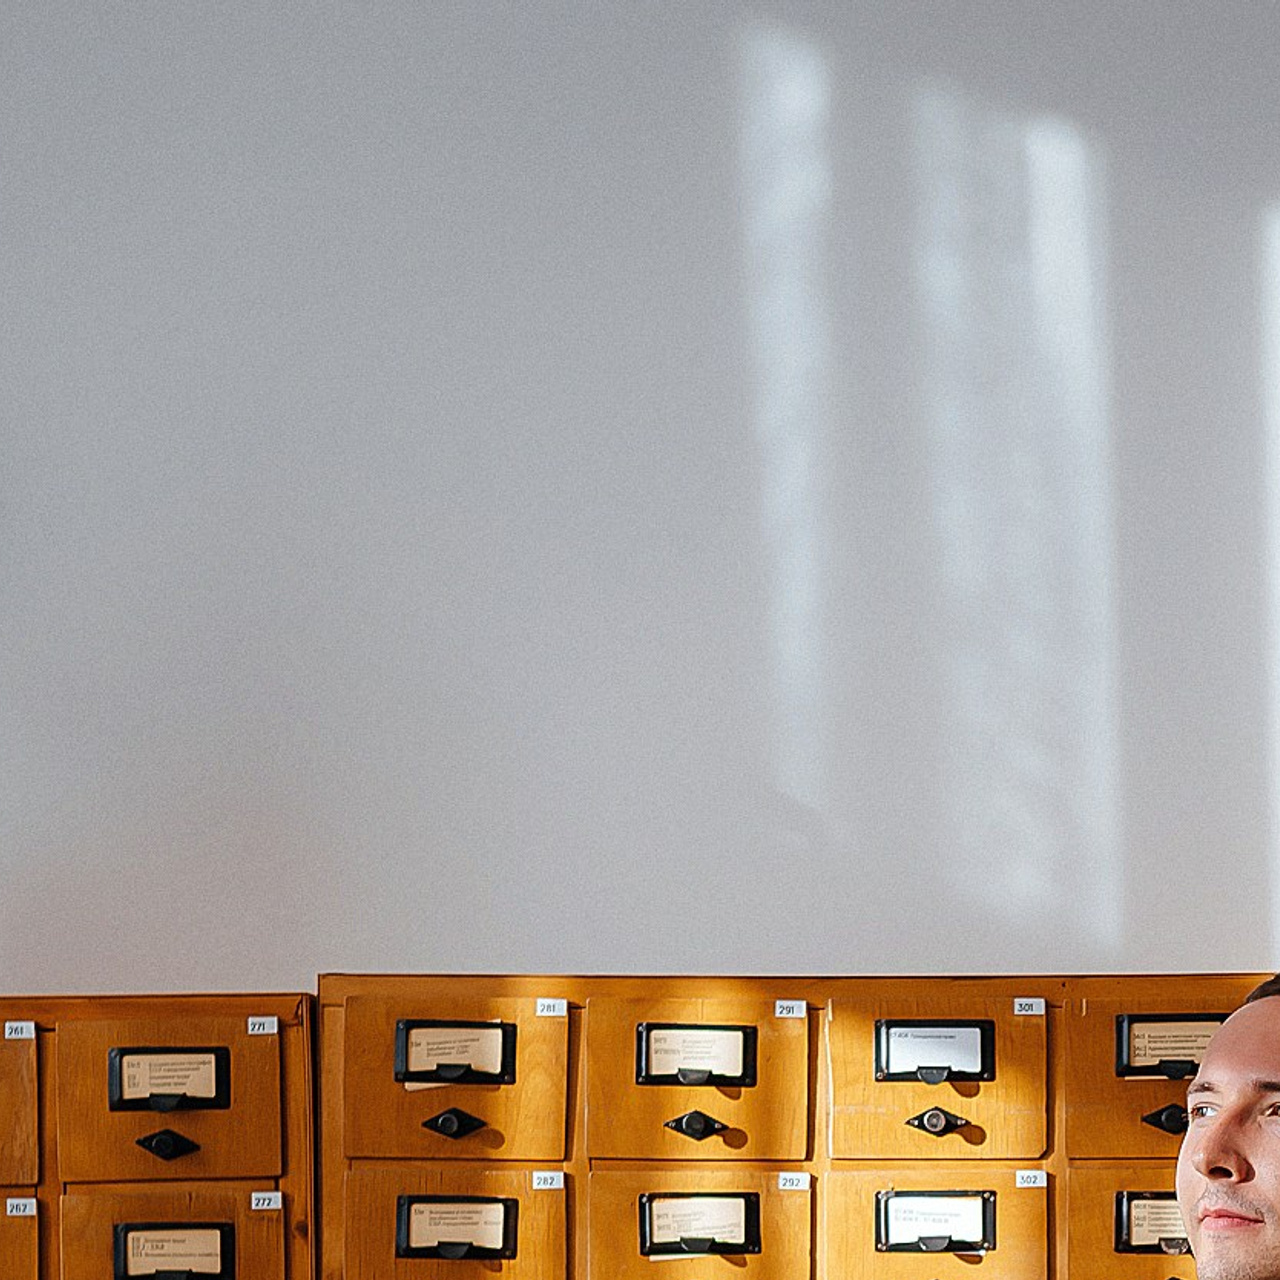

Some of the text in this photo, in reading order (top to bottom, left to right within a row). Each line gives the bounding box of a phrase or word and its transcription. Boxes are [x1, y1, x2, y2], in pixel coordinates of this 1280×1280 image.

[540, 1003, 557, 1014] 281
[778, 1004, 795, 1015] 291
[1017, 1002, 1034, 1013] 301
[250, 1021, 266, 1032] 271
[536, 1175, 556, 1187] 282
[781, 1177, 801, 1188] 292
[1019, 1174, 1039, 1185] 302
[254, 1197, 273, 1208] 272
[9, 1203, 28, 1214] 262
